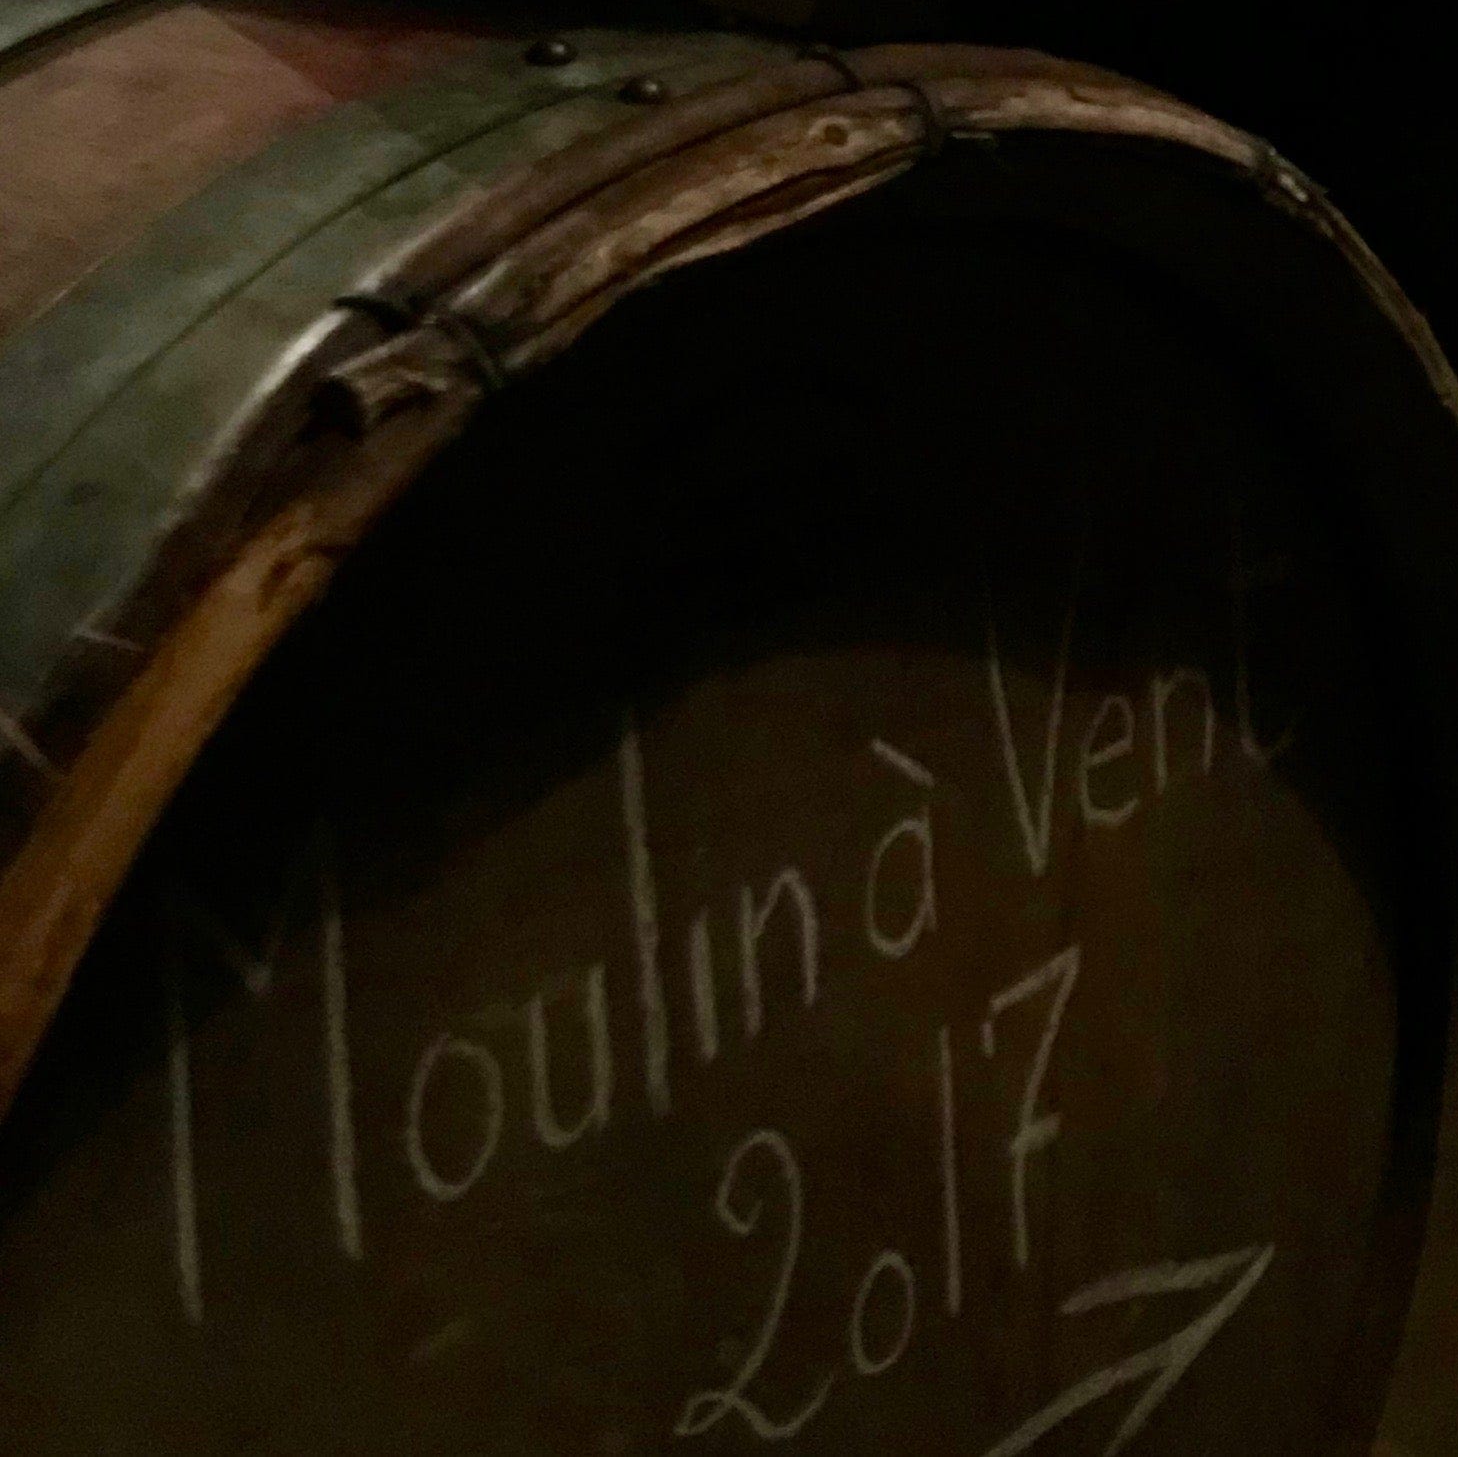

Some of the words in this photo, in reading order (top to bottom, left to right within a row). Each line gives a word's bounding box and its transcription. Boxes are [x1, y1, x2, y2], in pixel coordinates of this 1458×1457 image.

[160, 707, 820, 1327] Moulin
[862, 736, 938, 960] à
[672, 942, 1082, 1442] 2017
